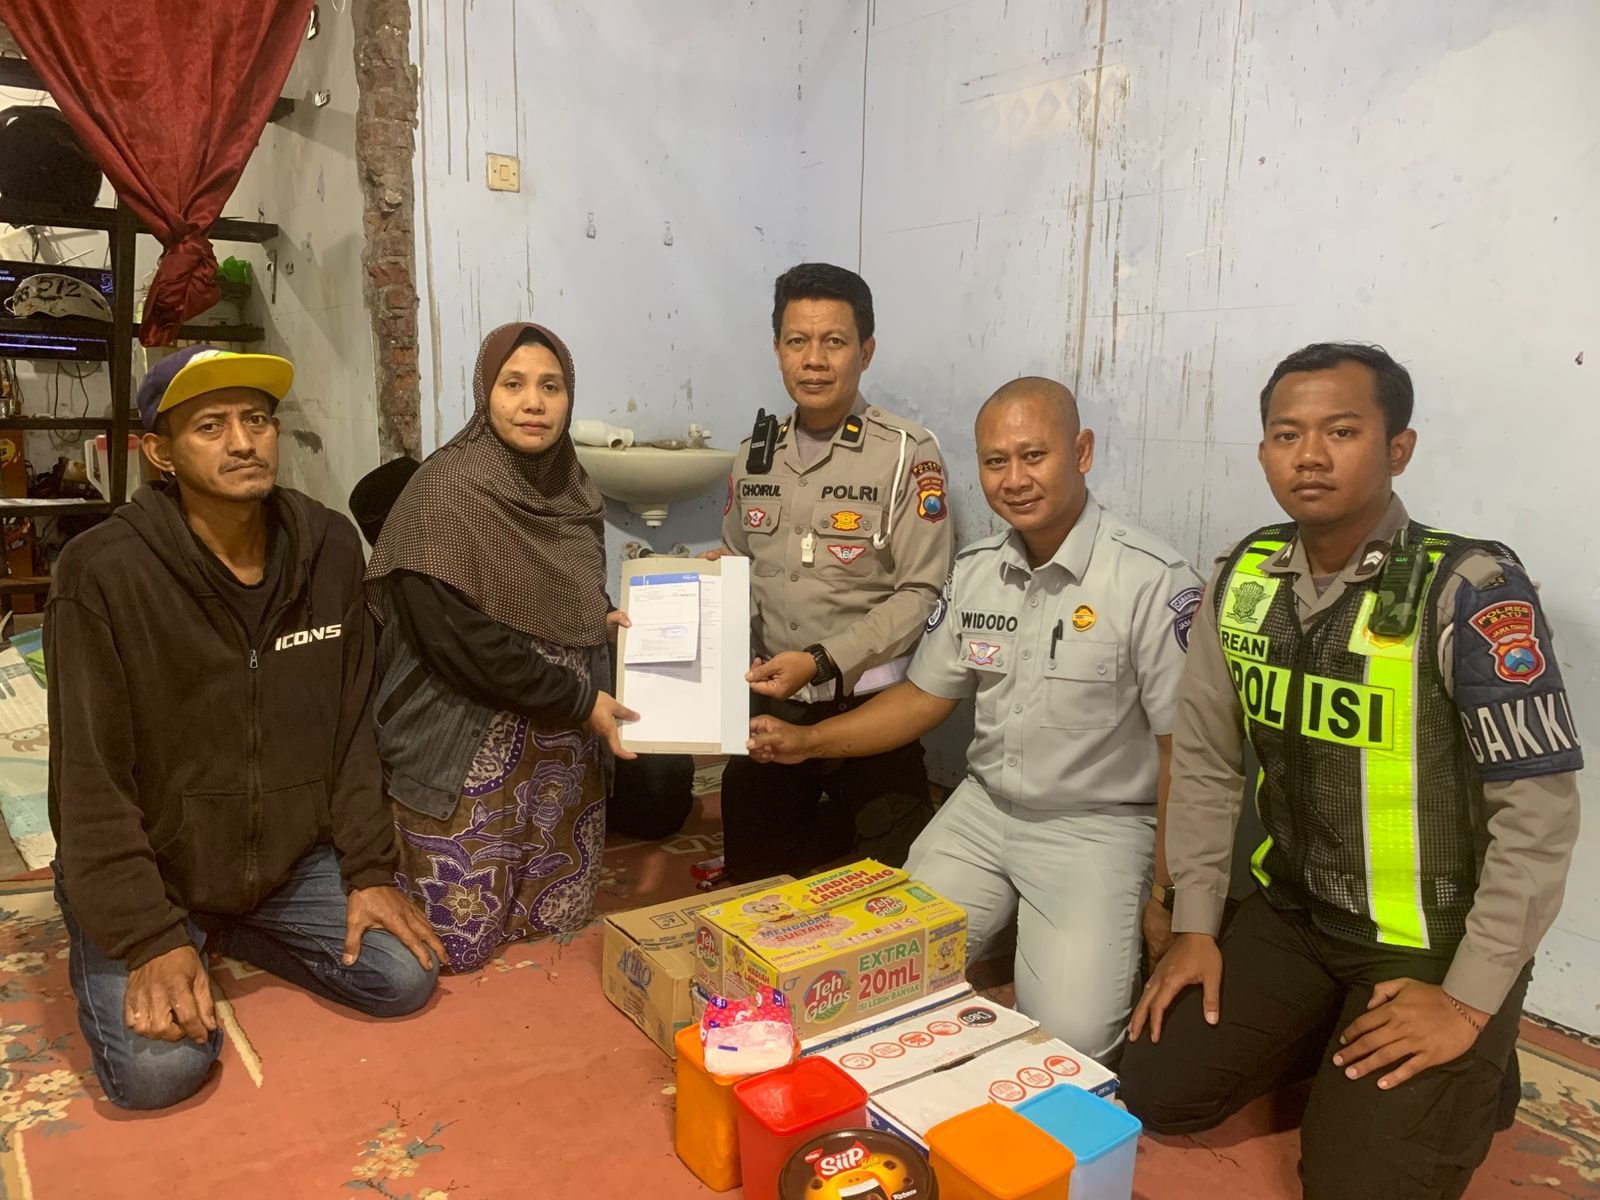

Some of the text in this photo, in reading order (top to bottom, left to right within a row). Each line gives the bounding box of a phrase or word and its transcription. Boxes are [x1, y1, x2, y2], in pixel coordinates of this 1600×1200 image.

[742, 484, 782, 498] CHOIRUL
[821, 485, 878, 502] POLRI
[960, 611, 1018, 633] WIDODO
[1478, 605, 1529, 625] POLRES
[1490, 611, 1521, 624] BATU
[275, 623, 342, 651] ICONS
[809, 870, 869, 896] HADIAH
[809, 869, 895, 905] LANGSUNG
[761, 912, 830, 937] MENDADAK
[859, 939, 921, 973] EXTRA
[812, 975, 842, 1001] Teh
[859, 957, 921, 1001] 20mL
[891, 983, 920, 1000] BANYAK
[804, 990, 851, 1023] Gelas
[820, 1147, 864, 1176] SiiP
